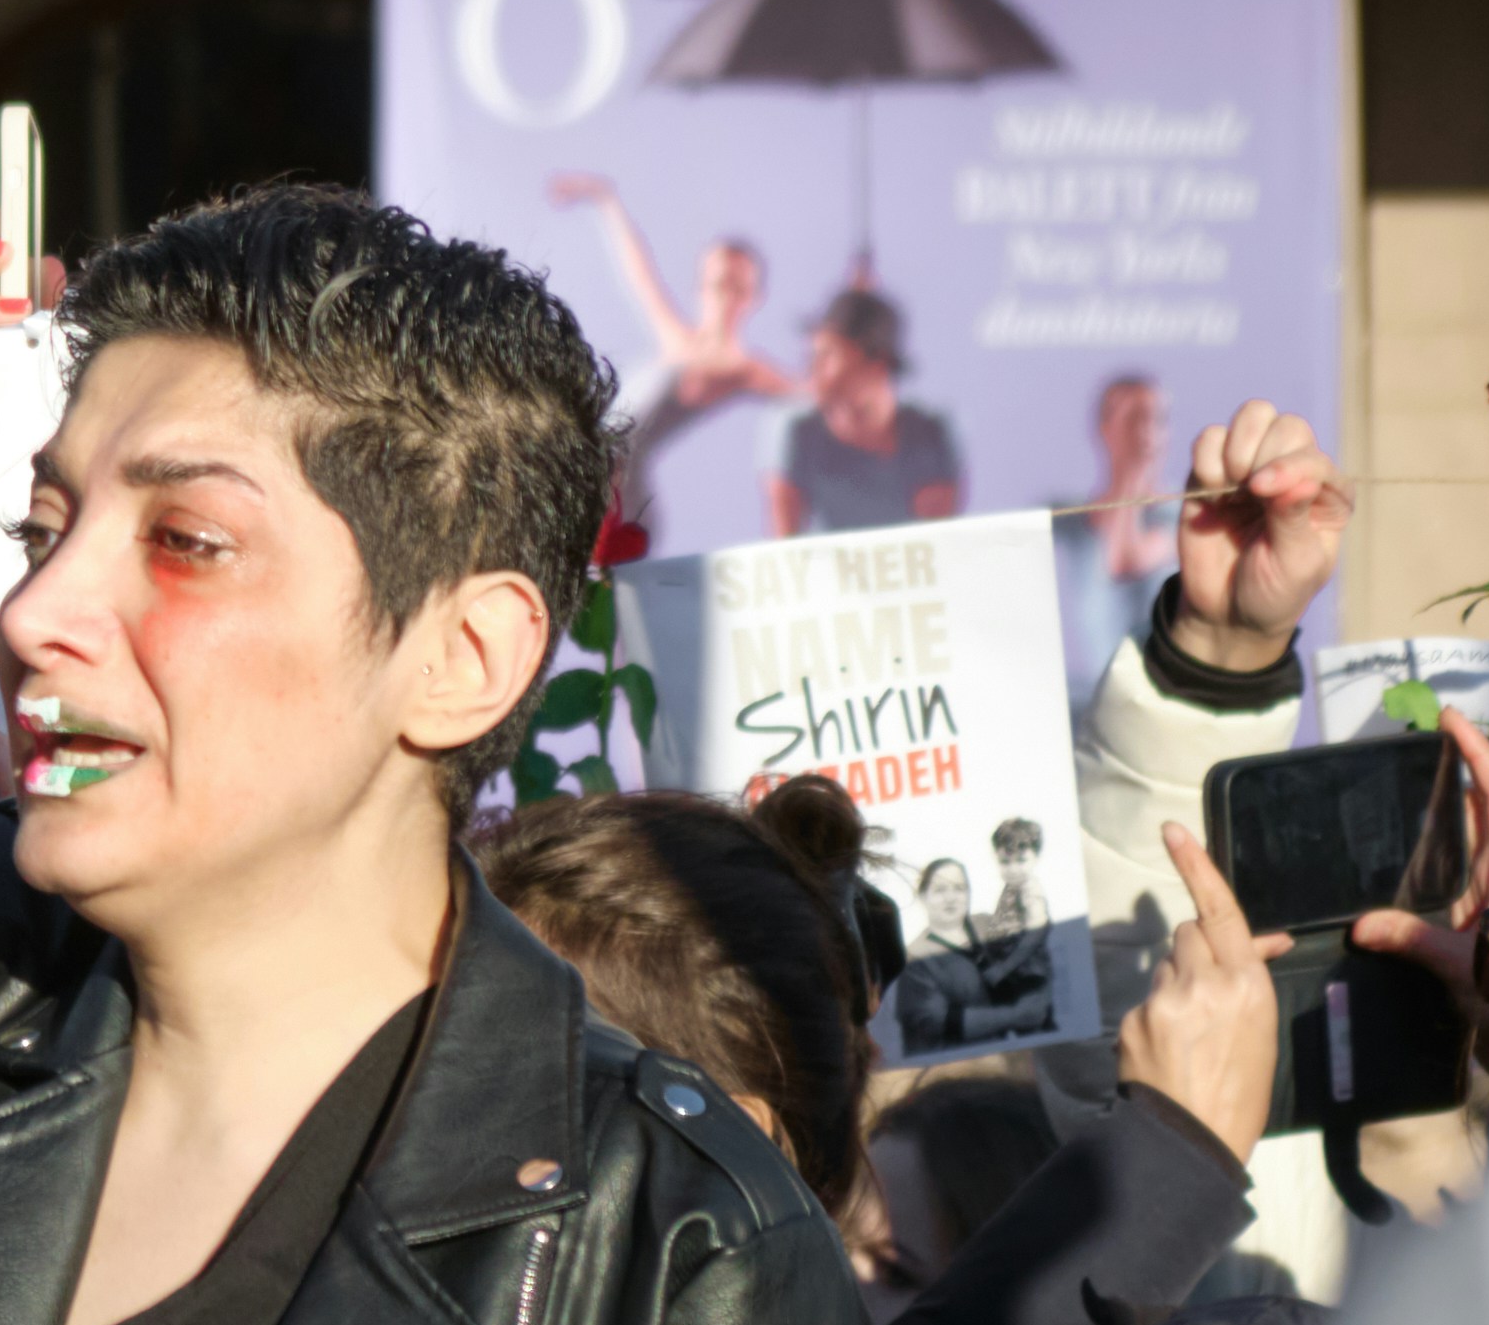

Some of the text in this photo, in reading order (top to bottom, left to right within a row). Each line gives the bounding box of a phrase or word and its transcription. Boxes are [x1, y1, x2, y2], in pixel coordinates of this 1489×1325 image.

[715, 540, 937, 612] SAY HER
[731, 601, 952, 706] NAME
[734, 655, 960, 769] Shirin
